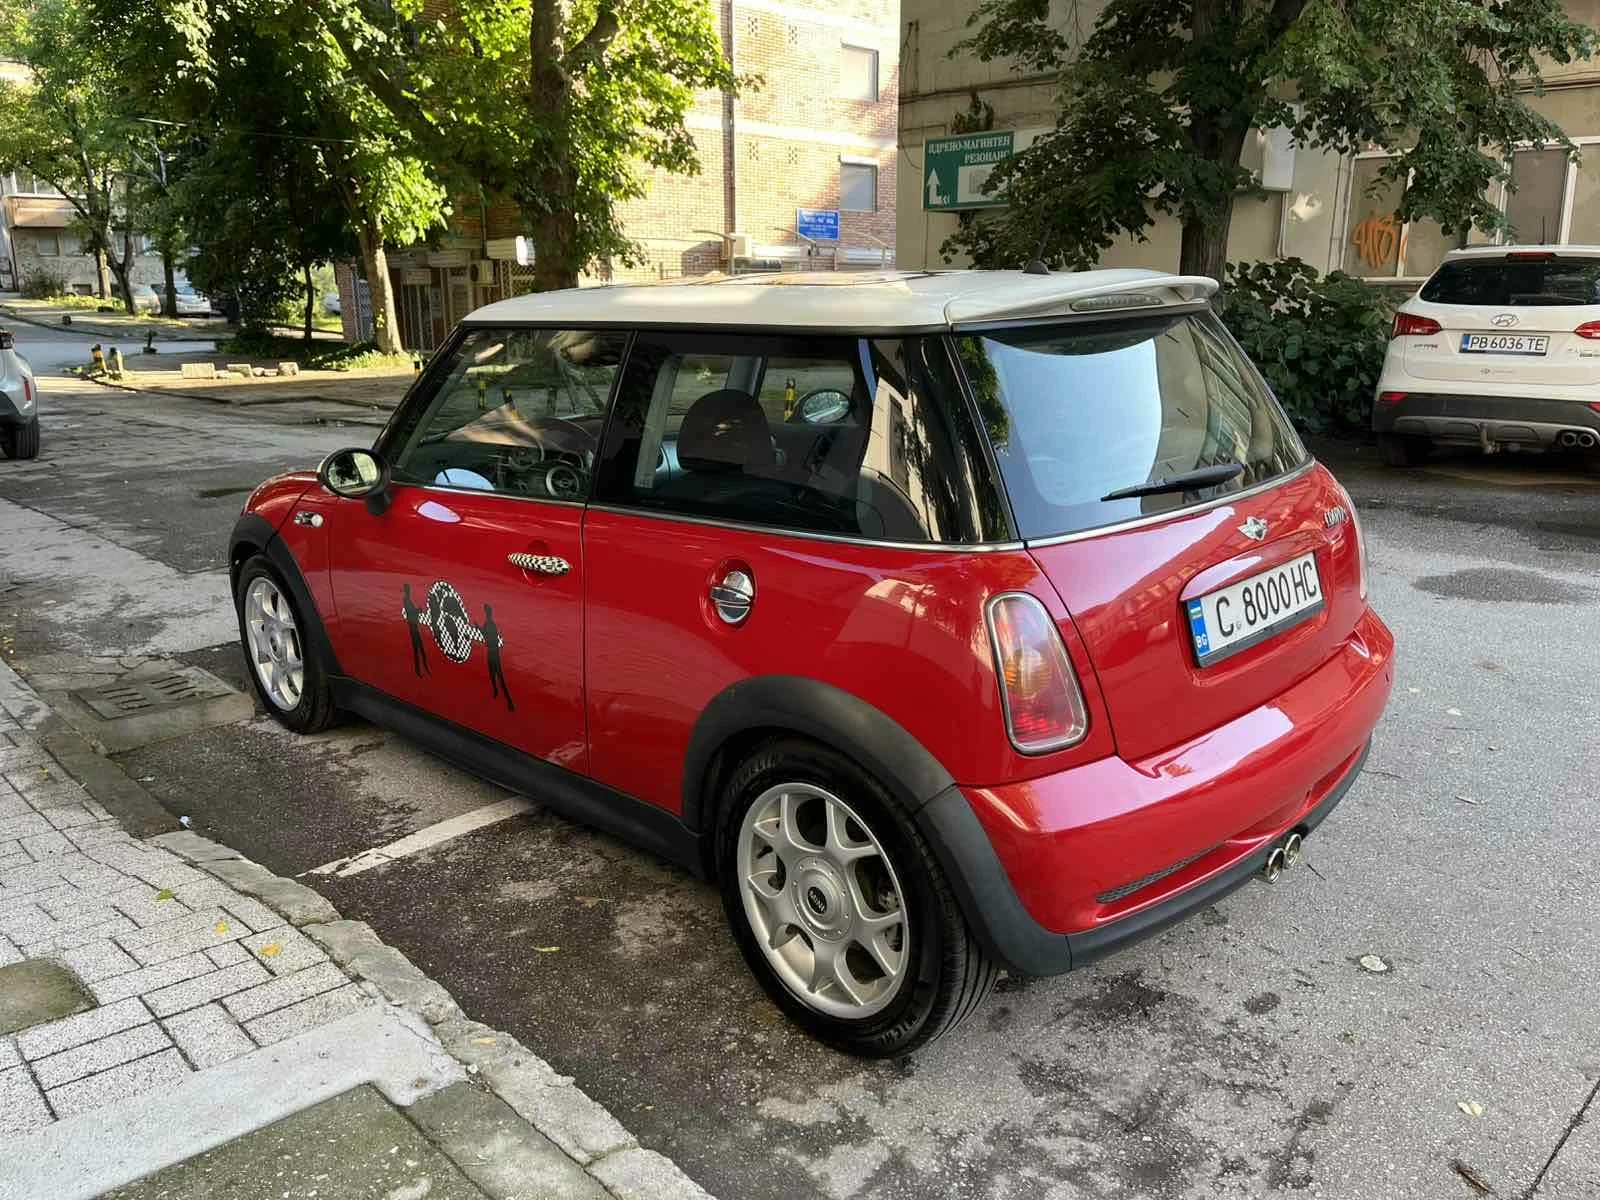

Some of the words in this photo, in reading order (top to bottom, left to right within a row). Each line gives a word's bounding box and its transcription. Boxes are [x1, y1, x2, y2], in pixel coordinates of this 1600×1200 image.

[1470, 336, 1488, 349] PB
[1490, 336, 1524, 350] 6036
[1527, 338, 1545, 351] TE
[1215, 596, 1234, 638] C
[1241, 571, 1292, 626] 8000
[1291, 560, 1318, 605] HC
[1195, 633, 1208, 649] BG
